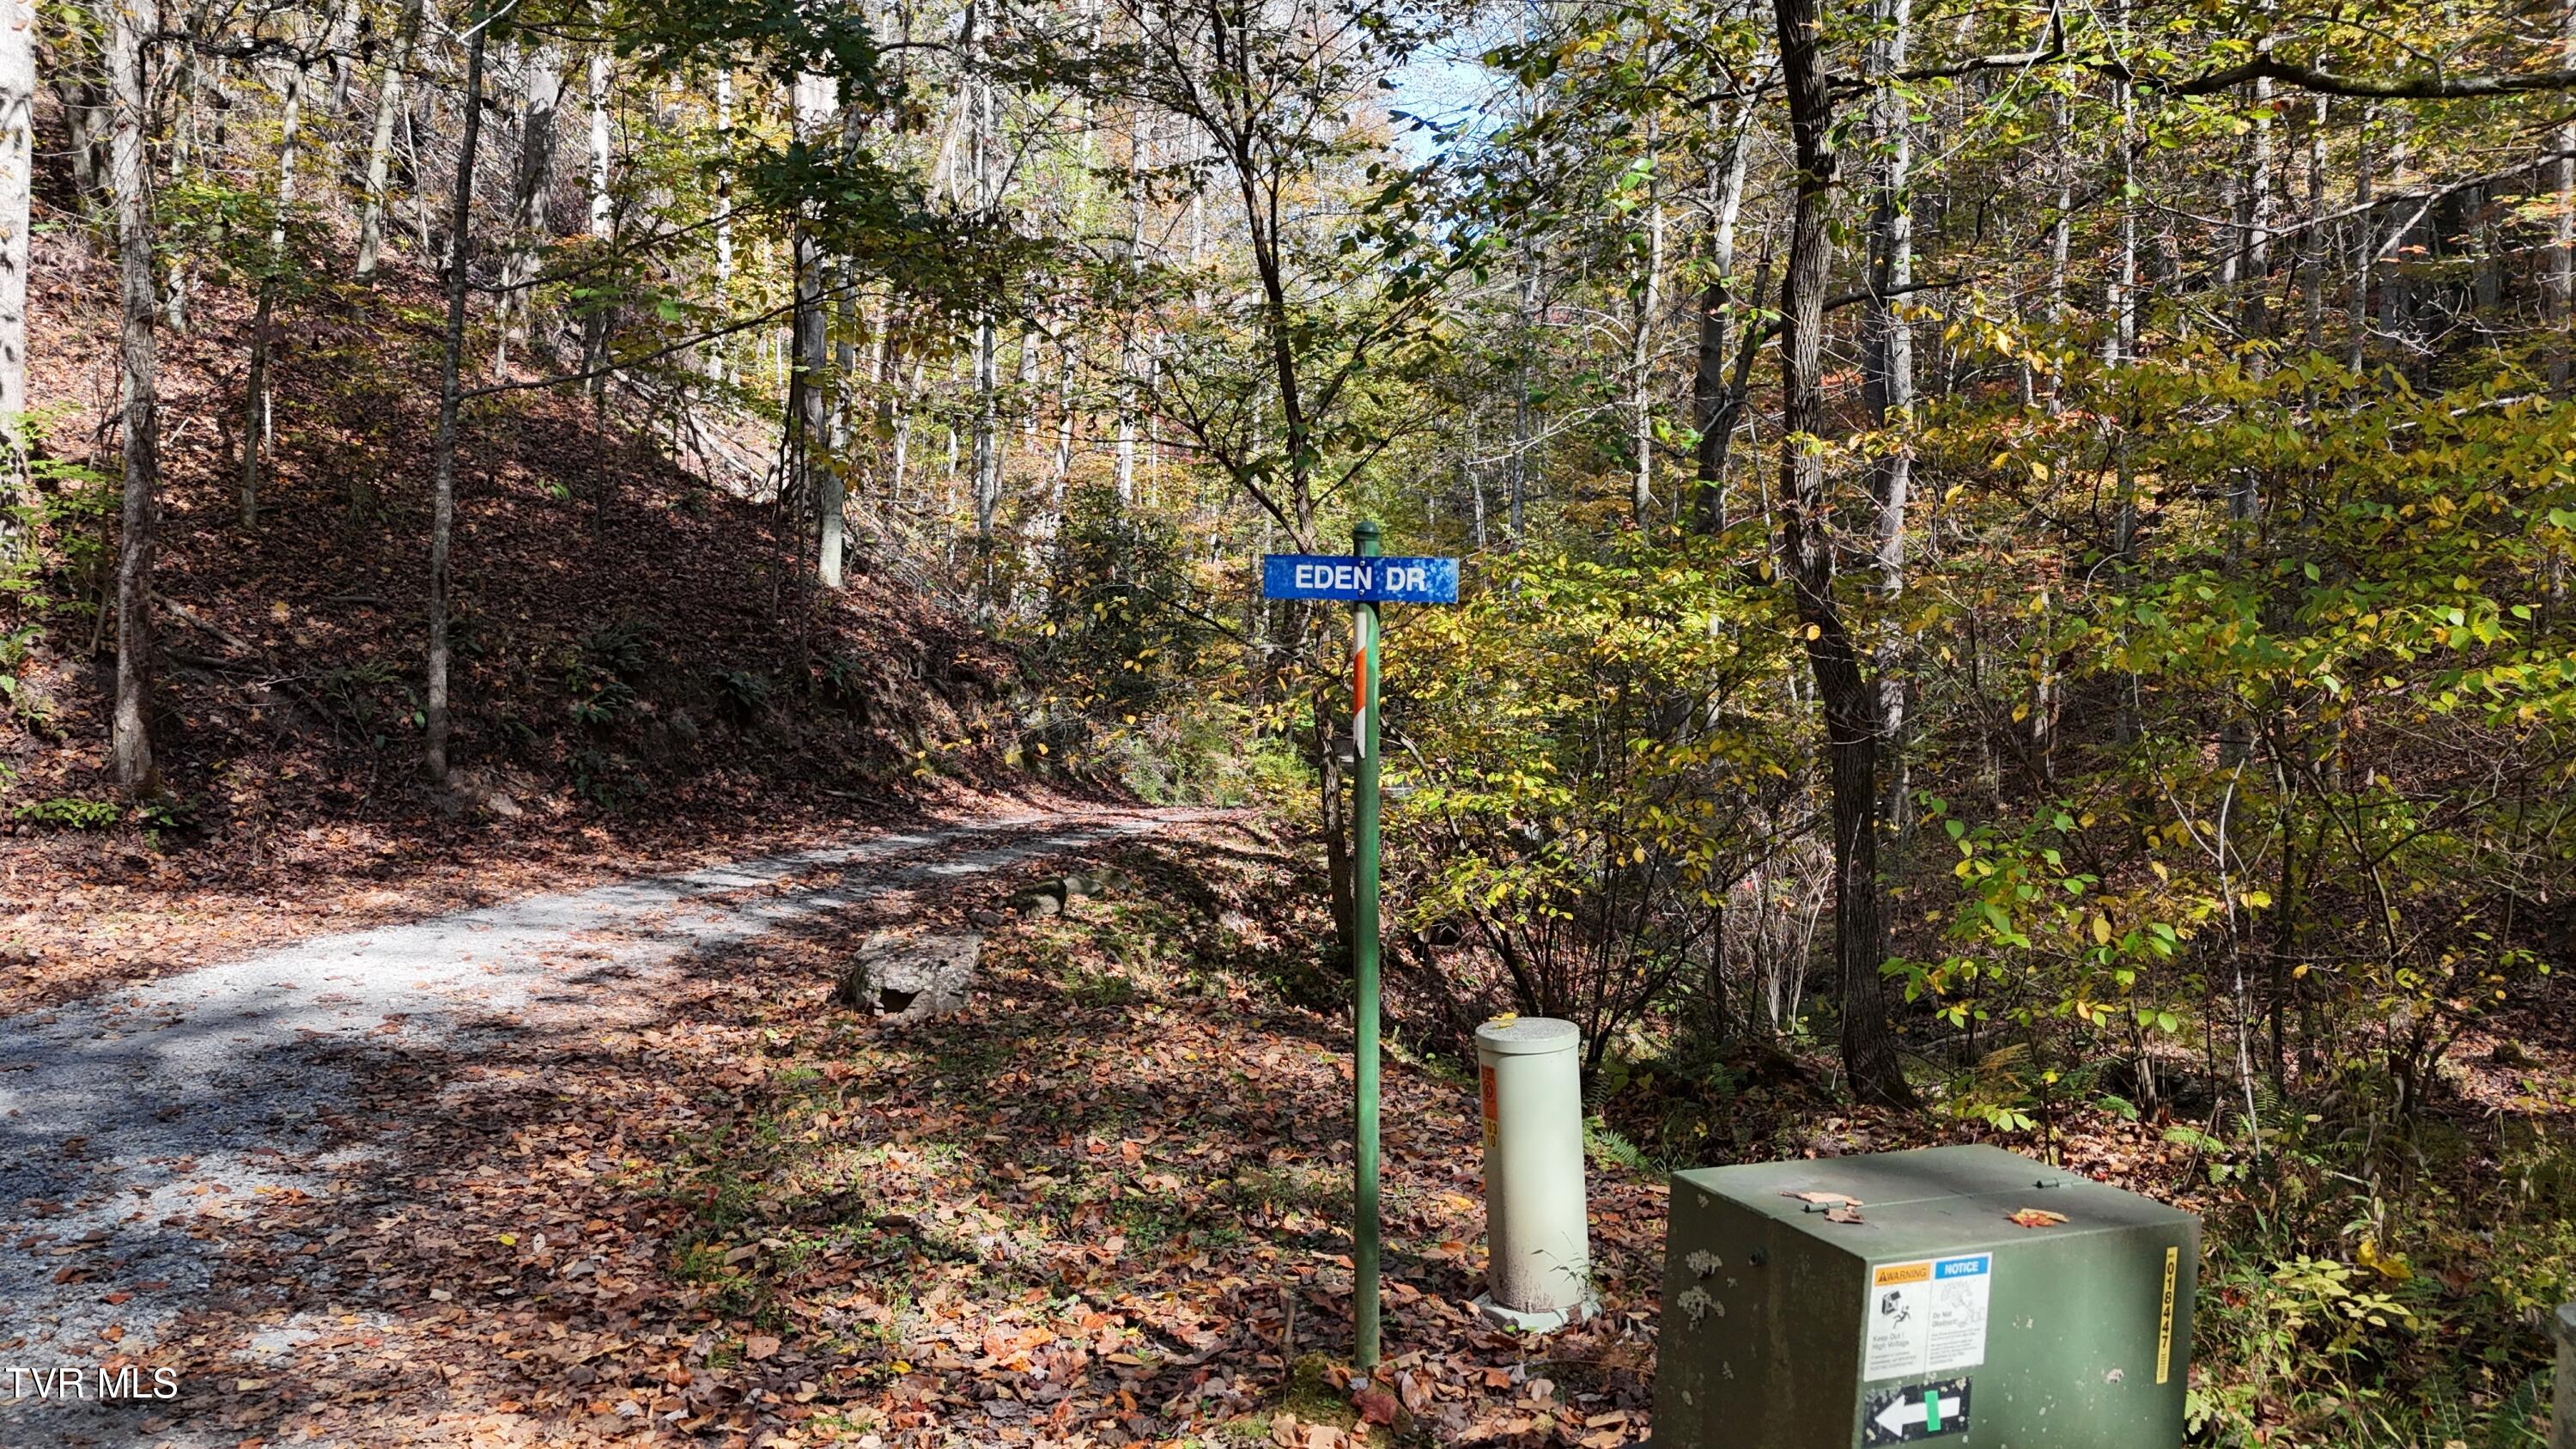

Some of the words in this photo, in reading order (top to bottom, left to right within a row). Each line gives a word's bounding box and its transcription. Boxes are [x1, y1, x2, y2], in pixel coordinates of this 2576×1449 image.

[1295, 565, 1372, 589] EDEN
[1386, 567, 1426, 591] DR
[1886, 1269, 1927, 1282] WARNING
[1944, 1261, 1979, 1275] NOTICE
[2161, 1262, 2174, 1349] 018447
